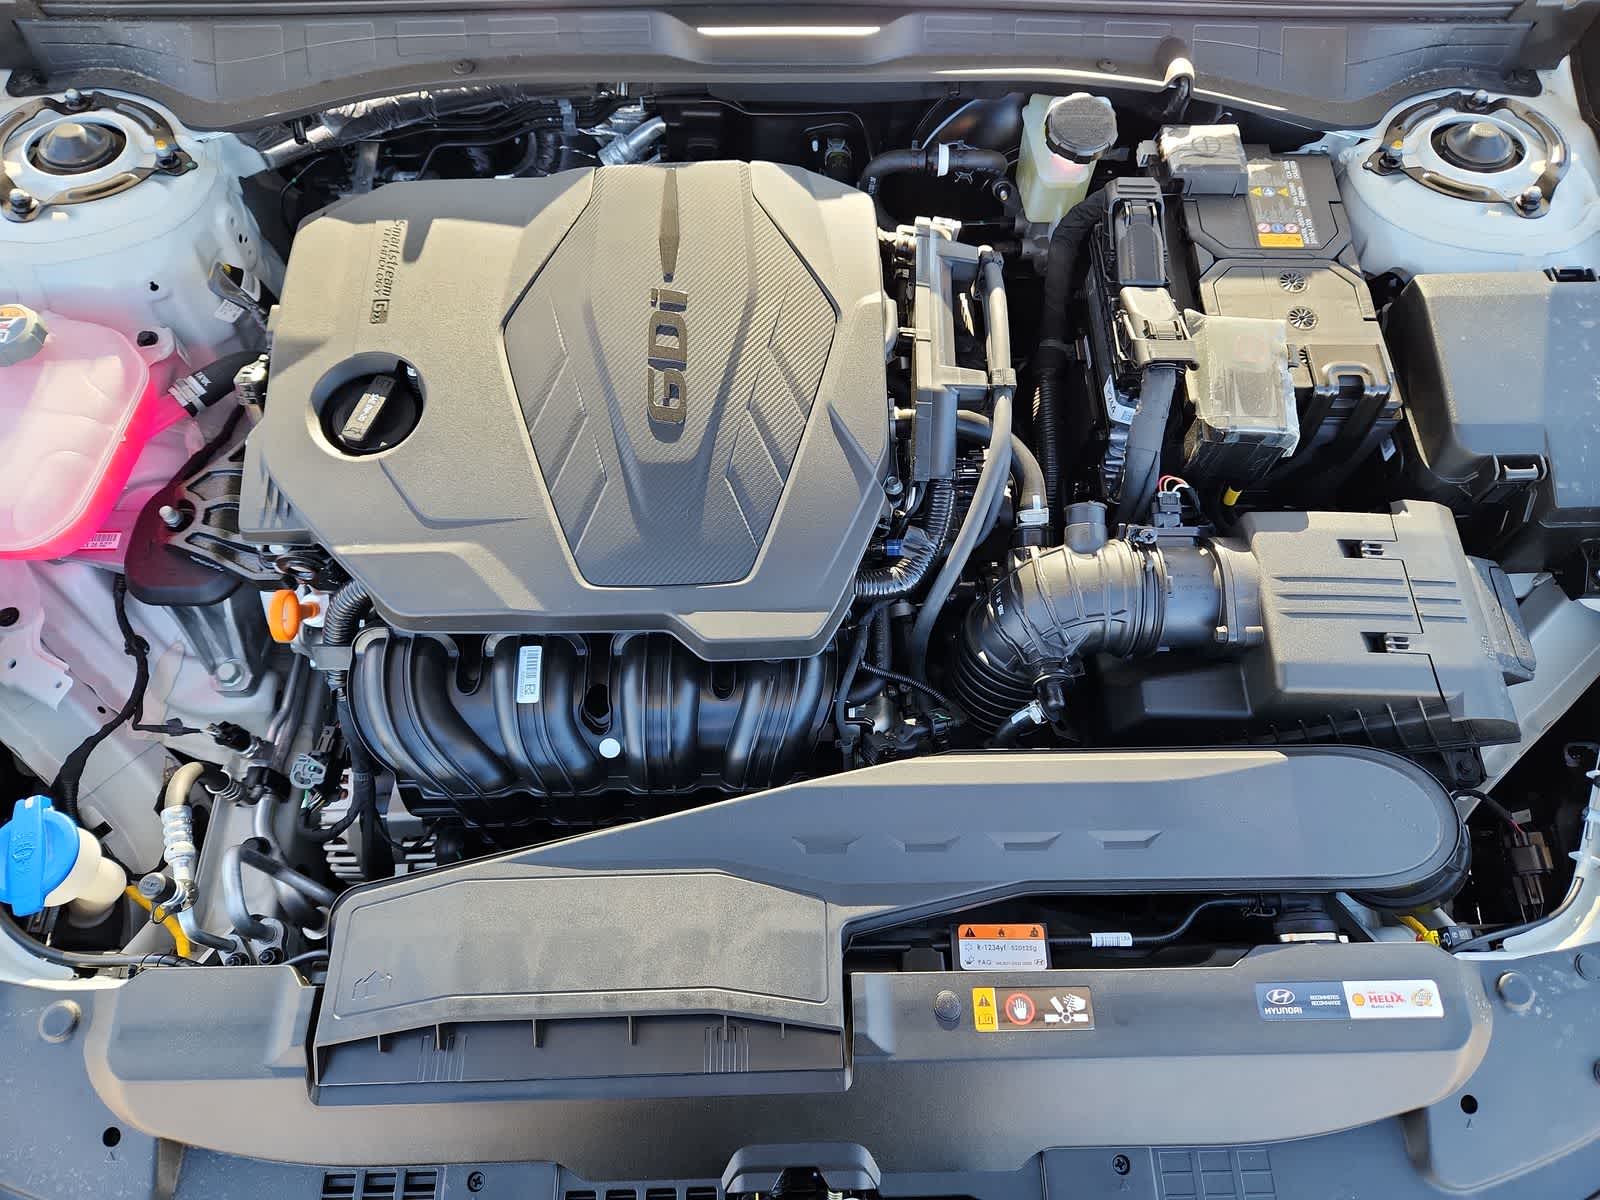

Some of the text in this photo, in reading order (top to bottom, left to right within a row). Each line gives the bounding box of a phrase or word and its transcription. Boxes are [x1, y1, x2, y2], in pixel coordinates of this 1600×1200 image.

[382, 220, 406, 297] Smartstream
[1368, 992, 1404, 1003] HELIX
[1264, 1007, 1303, 1015] HYUNDAI
